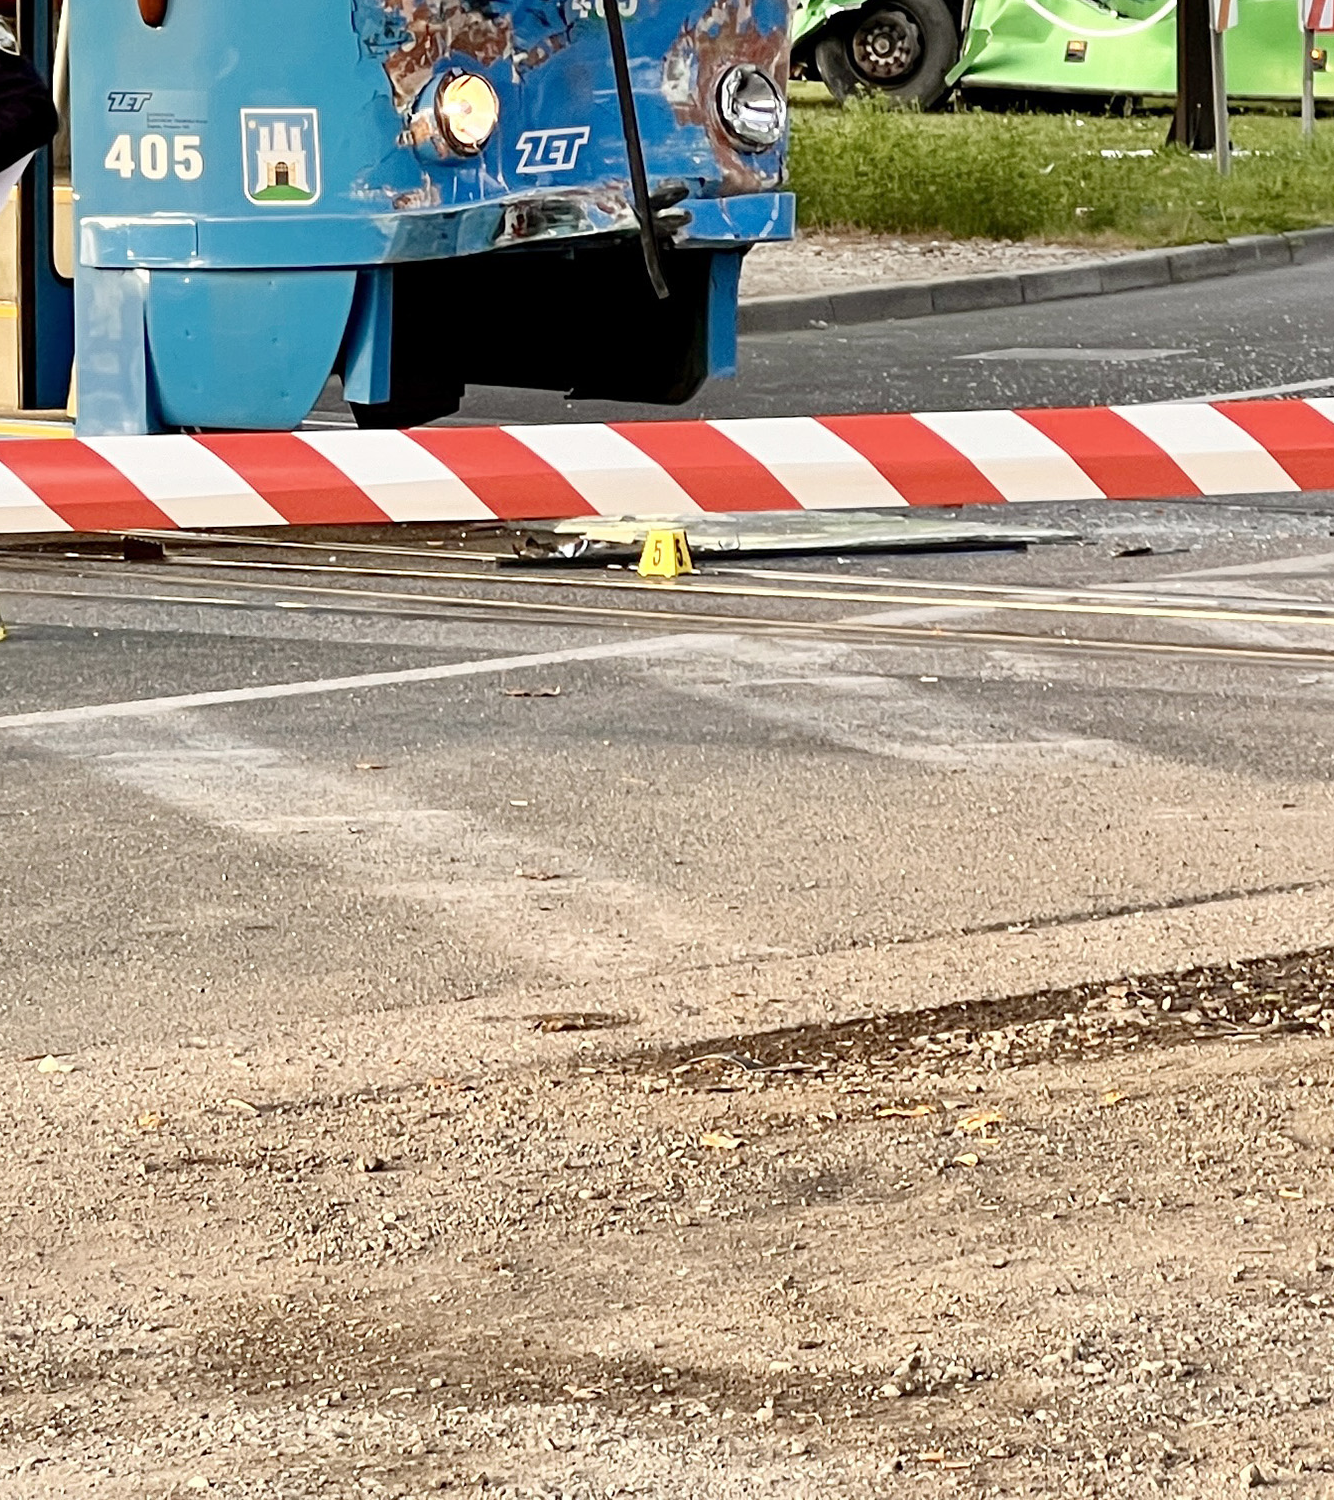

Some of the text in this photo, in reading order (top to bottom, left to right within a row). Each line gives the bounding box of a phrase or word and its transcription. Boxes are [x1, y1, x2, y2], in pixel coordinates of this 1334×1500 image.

[108, 91, 153, 112] ZET
[105, 134, 204, 180] 405
[516, 126, 590, 174] ZET
[653, 539, 662, 567] 5
